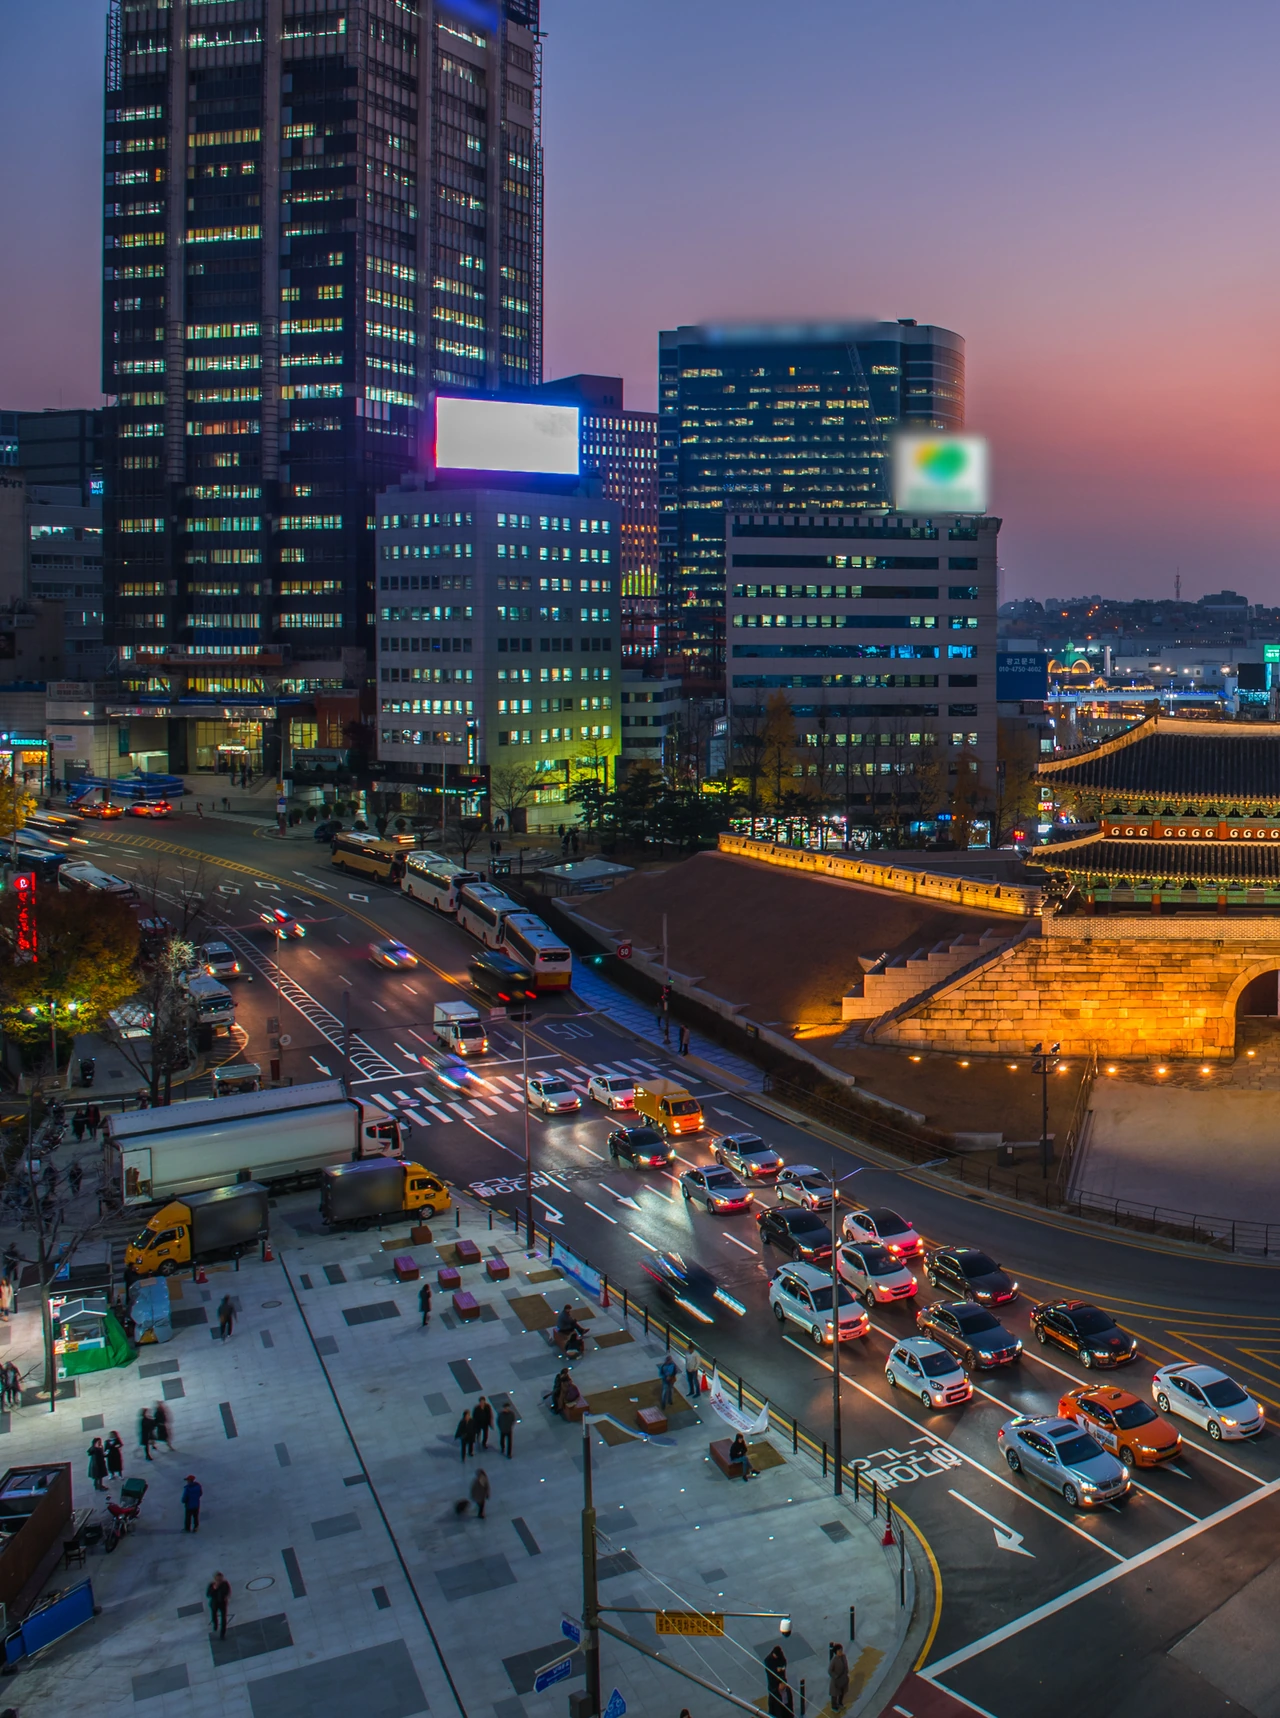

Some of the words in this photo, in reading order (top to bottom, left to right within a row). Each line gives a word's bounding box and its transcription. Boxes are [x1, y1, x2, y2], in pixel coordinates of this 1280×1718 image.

[1006, 657, 1036, 666] 광고문의
[620, 948, 629, 956] 50
[544, 1022, 595, 1040] 50
[847, 1435, 963, 1492] 한국은행
